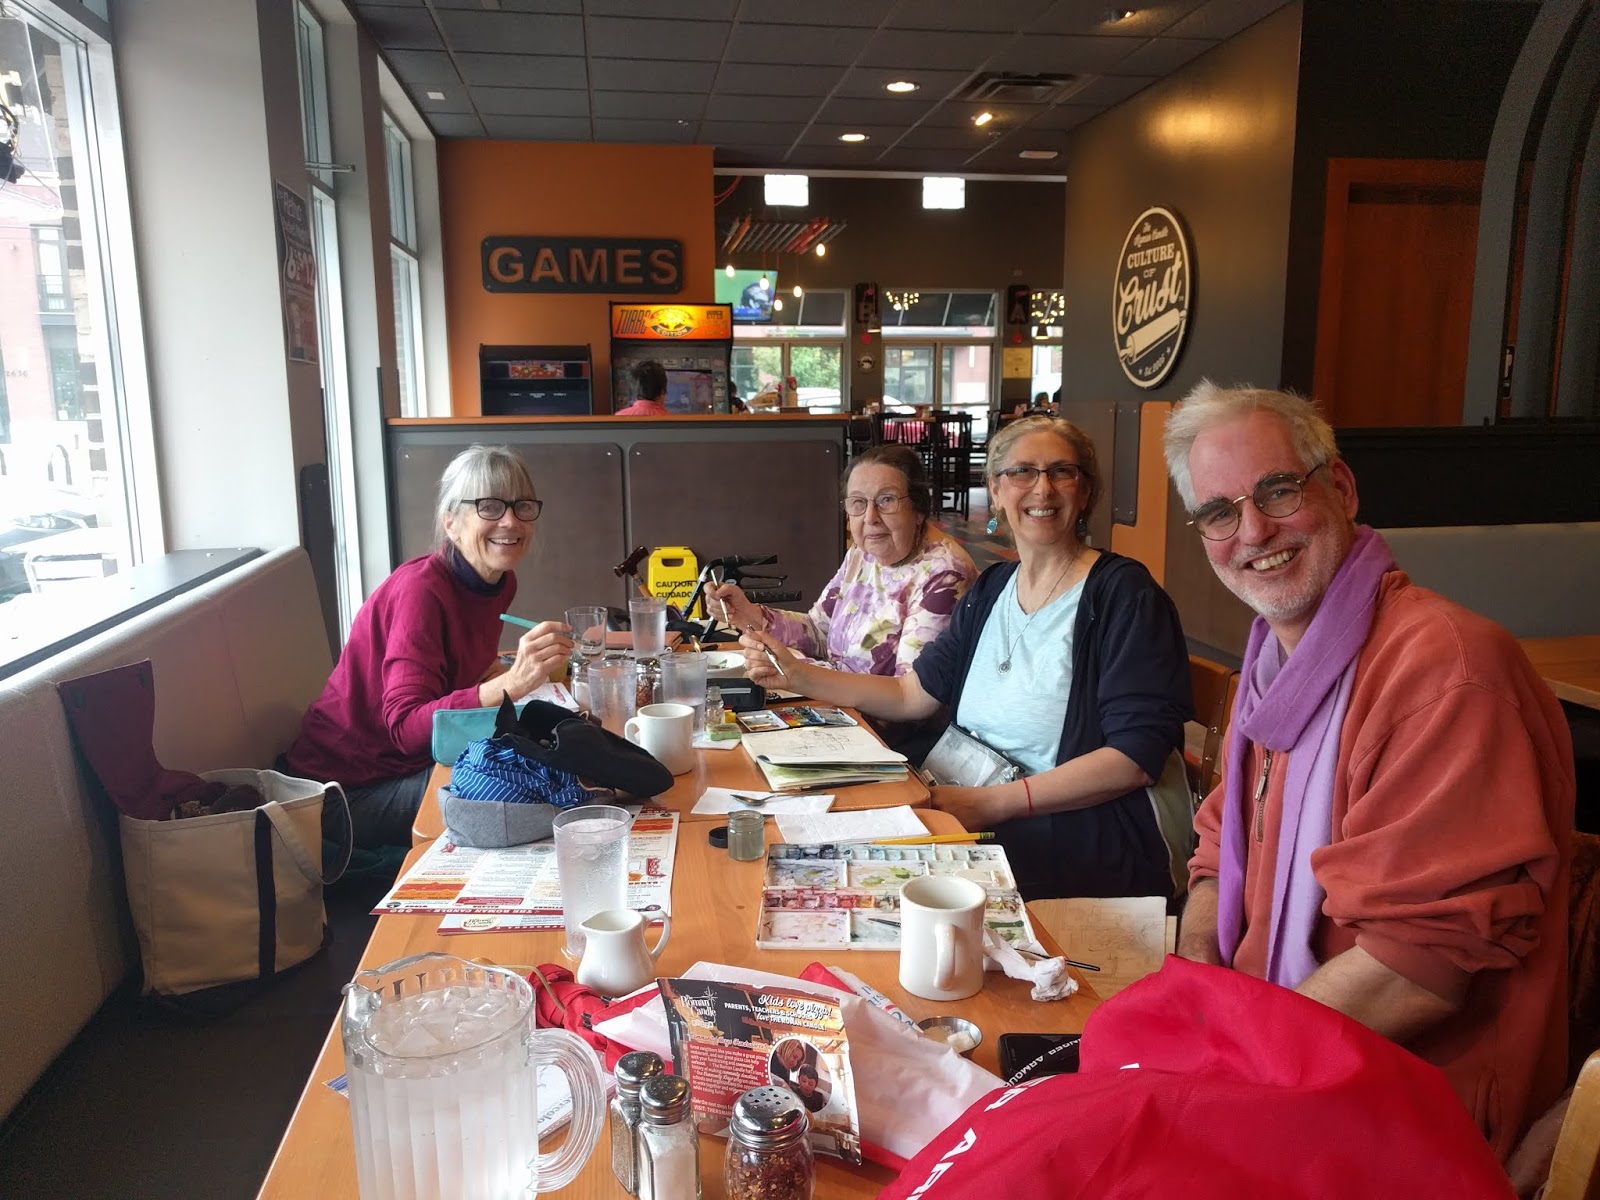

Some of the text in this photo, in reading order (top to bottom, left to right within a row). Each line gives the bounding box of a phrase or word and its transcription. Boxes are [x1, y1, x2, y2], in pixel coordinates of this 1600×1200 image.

[1127, 243, 1175, 269] CULTURE
[489, 247, 678, 285] GAMES
[1143, 267, 1156, 279] OF
[1118, 250, 1183, 336] Crust
[680, 996, 710, 1007] Roman
[724, 1003, 751, 1012] PARENTS,
[758, 994, 784, 1007] Kids
[787, 998, 807, 1010] love
[691, 1006, 717, 1018] Candle
